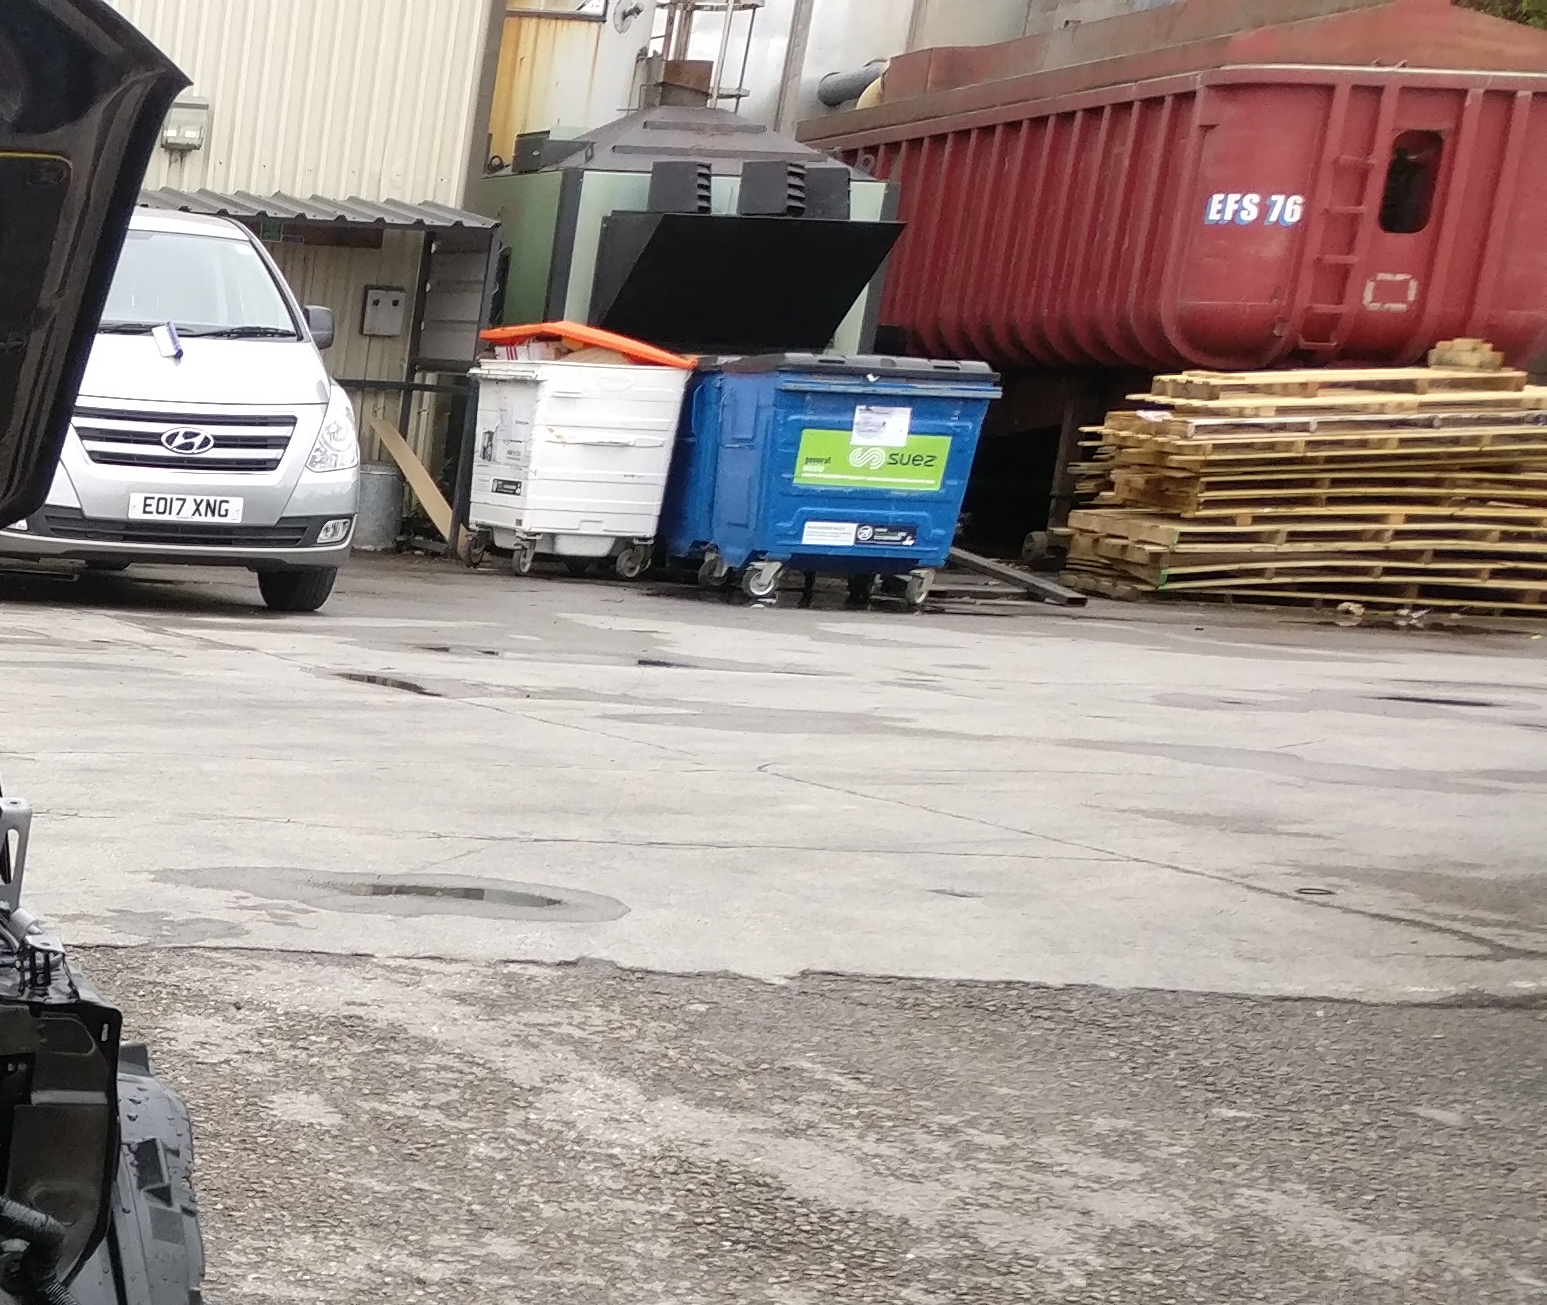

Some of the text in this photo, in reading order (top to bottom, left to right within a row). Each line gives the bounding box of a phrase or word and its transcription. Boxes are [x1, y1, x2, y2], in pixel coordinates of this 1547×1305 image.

[1206, 193, 1304, 225] EFS 76
[887, 452, 938, 467] suez
[191, 498, 230, 518] XNG
